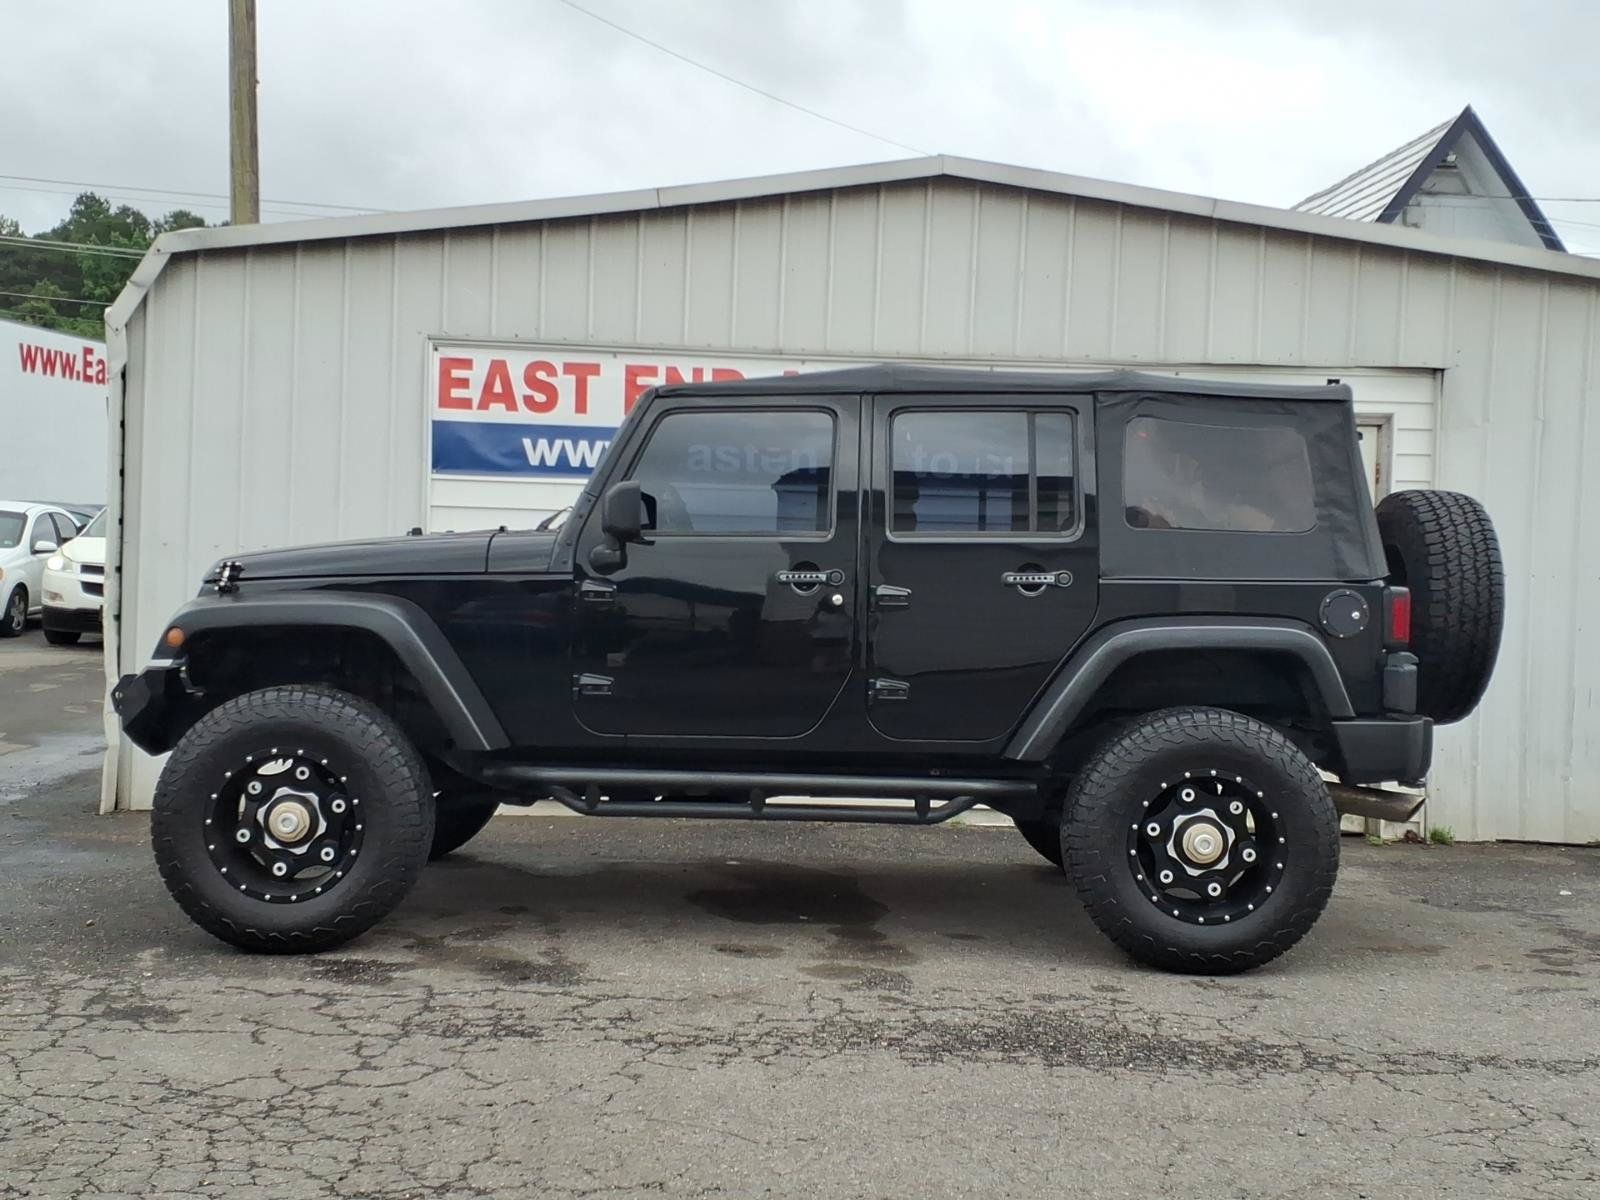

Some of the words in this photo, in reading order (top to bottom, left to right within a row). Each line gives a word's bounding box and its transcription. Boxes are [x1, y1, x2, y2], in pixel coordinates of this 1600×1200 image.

[19, 342, 109, 386] www.Ea
[438, 357, 601, 414] EAST
[522, 438, 611, 468] ww
